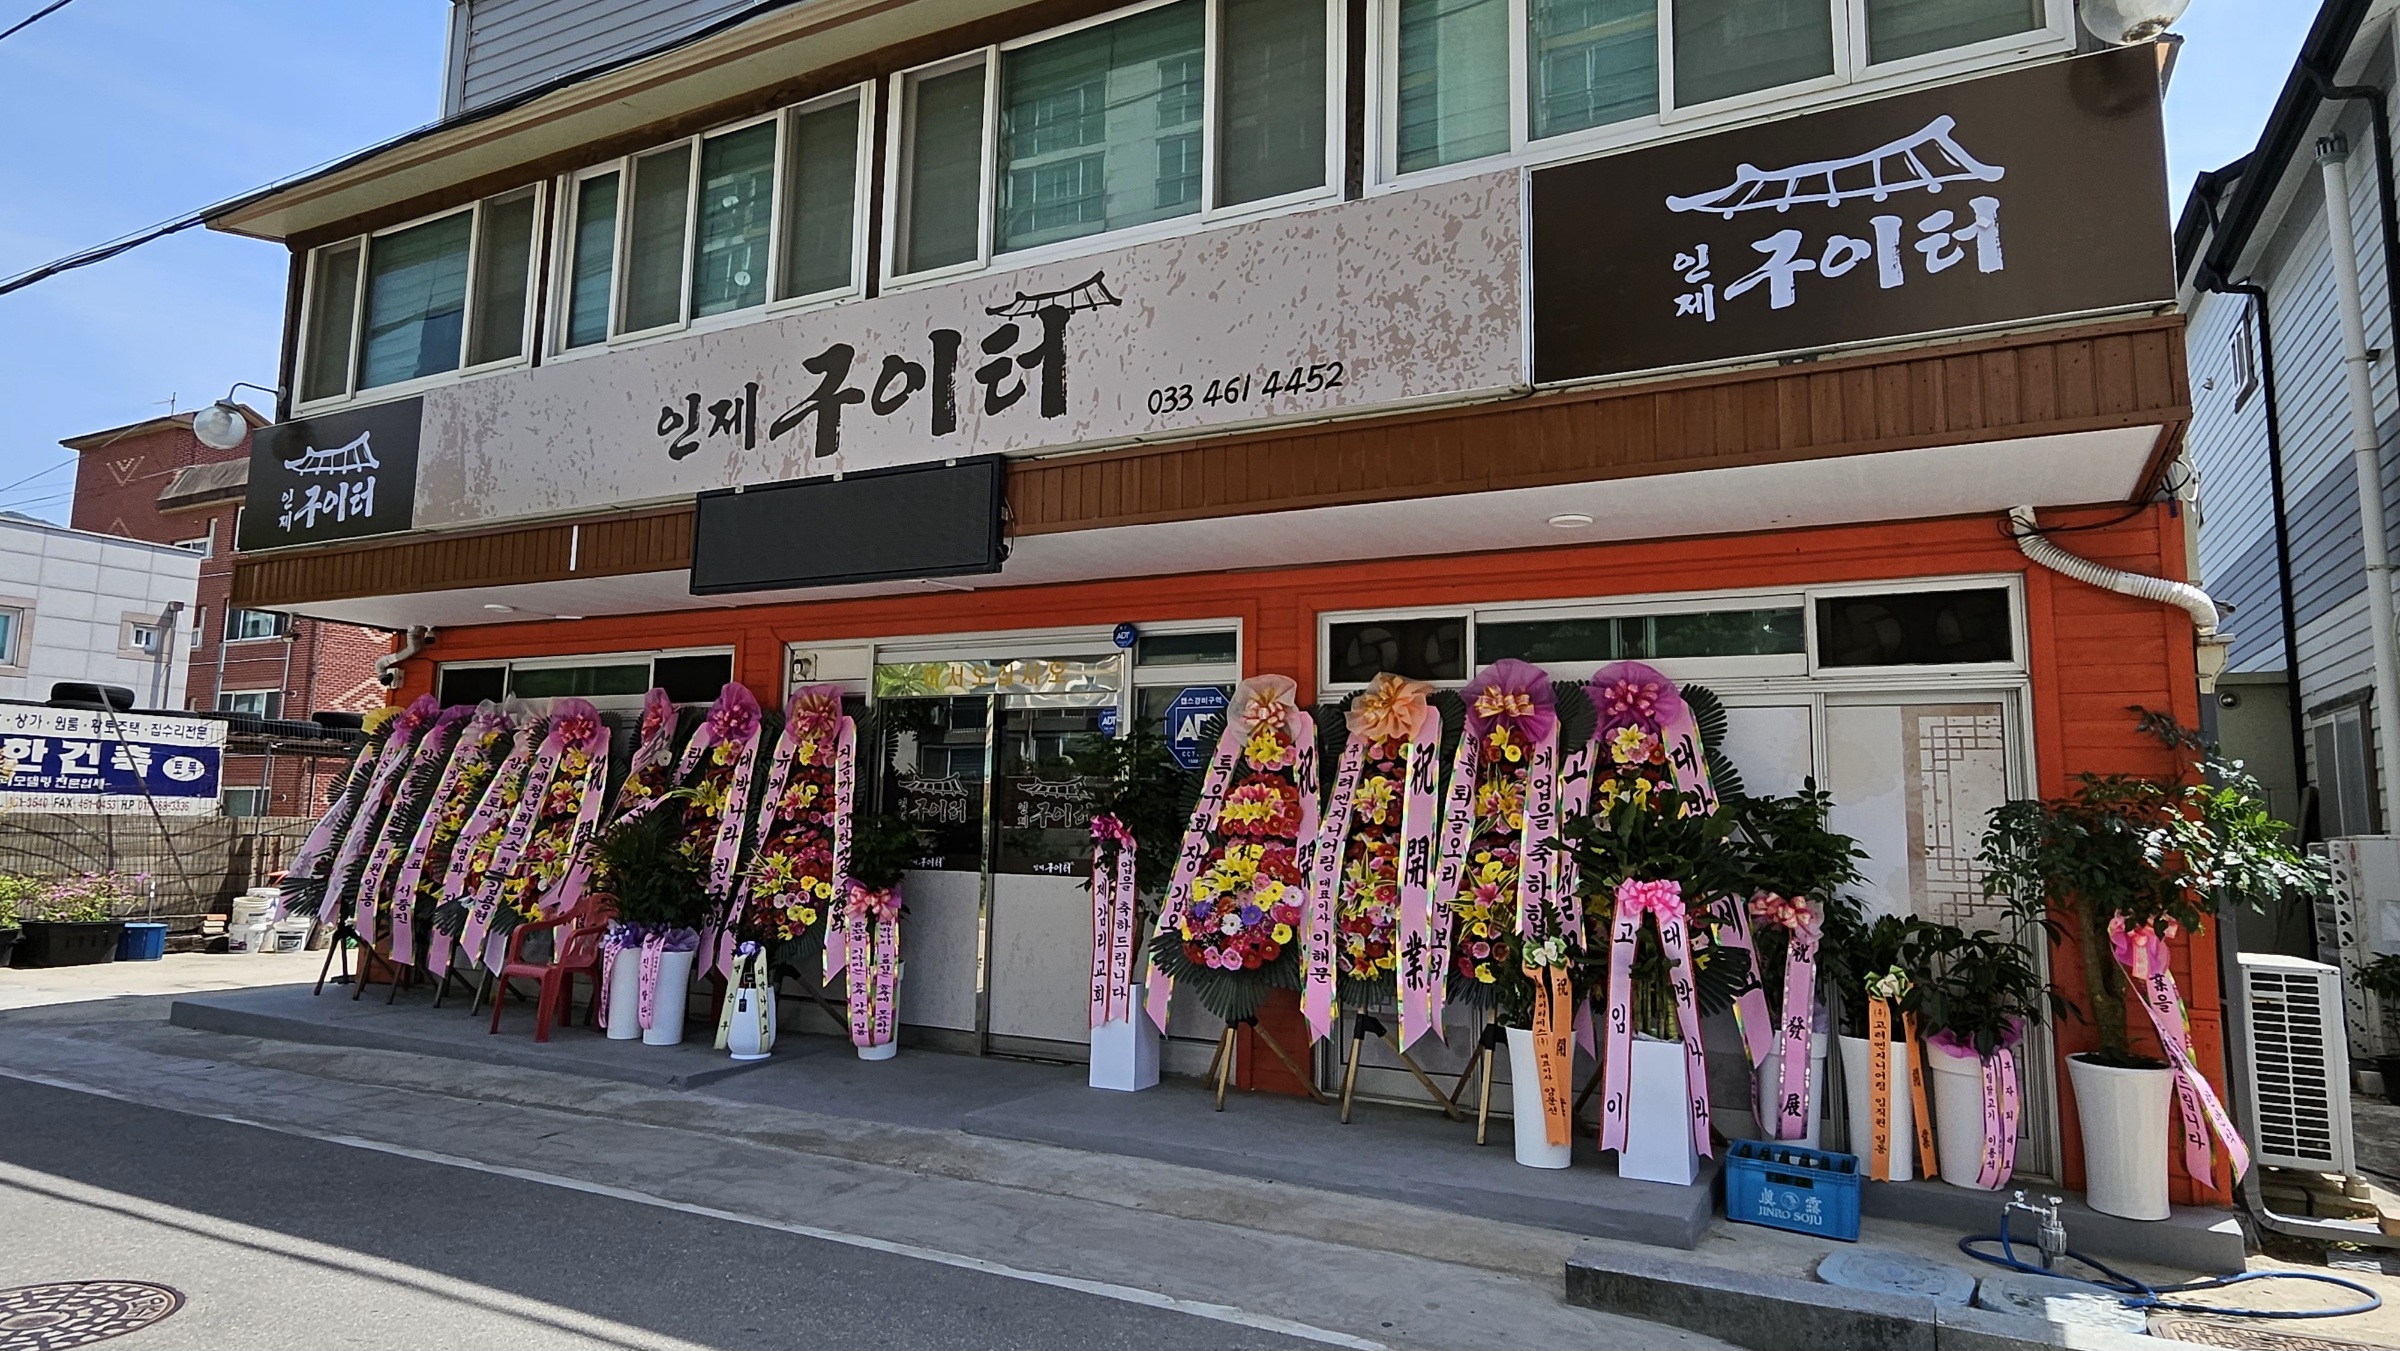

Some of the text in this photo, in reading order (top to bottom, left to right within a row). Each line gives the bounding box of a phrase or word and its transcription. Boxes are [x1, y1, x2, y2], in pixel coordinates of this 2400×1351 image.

[1673, 196, 2004, 322] 인제 구이터
[656, 304, 1069, 460] 인제 구이터
[1147, 361, 1344, 416] 033 461 4452
[278, 475, 376, 533] 인제 구이터
[1115, 631, 1131, 640] ADT
[15, 713, 208, 740] 상가 원룸 황토주택 집수리전문
[1180, 696, 1223, 706] 캡스경비구역
[53, 797, 73, 809] FAX
[722, 748, 753, 848] 대박나라
[765, 750, 792, 814] 뉴케어
[837, 744, 853, 806] 지금까지
[1529, 745, 1554, 830] 개업을
[838, 812, 852, 845] 이런
[1441, 782, 1472, 889] 퇴골오리
[1315, 877, 1332, 923] 대표이사
[1111, 901, 1132, 1001] 축하드립니다
[1308, 929, 1333, 985] 이해문
[1662, 920, 1710, 1132] 대박나라
[2003, 1060, 2015, 1170] 부자되세요
[1757, 1205, 1823, 1226] JINRO SOJU
